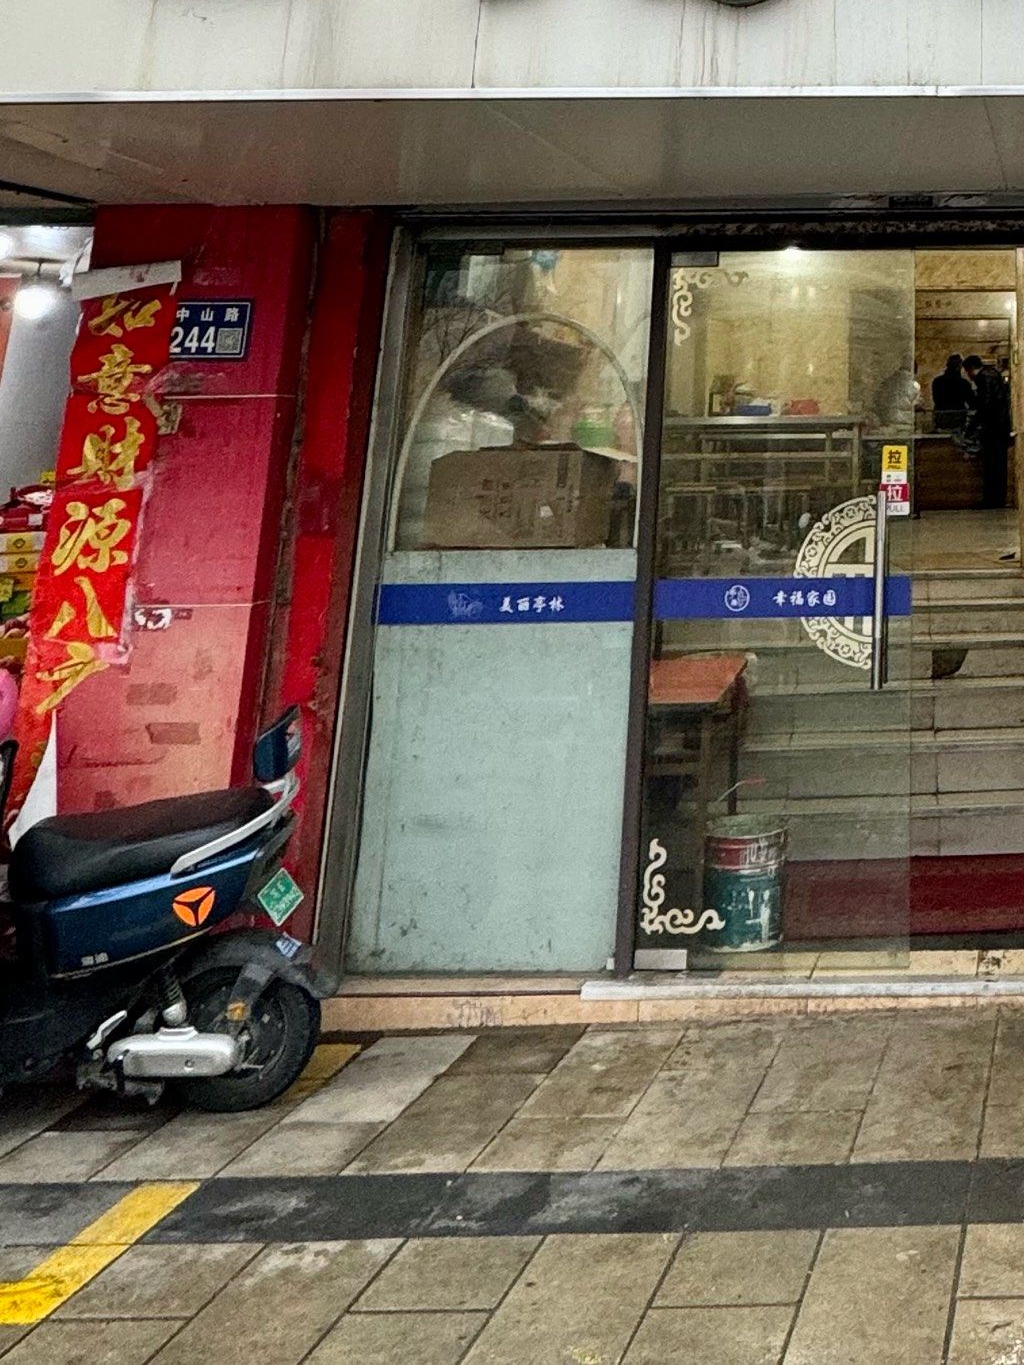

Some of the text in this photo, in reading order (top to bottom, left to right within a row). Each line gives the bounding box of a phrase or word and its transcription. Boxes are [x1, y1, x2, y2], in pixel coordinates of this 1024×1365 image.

[175, 306, 240, 323] 中山路
[168, 325, 216, 354] 244
[887, 449, 902, 464] 拉
[886, 484, 904, 502] 拉
[498, 595, 566, 614] 美丽亭林
